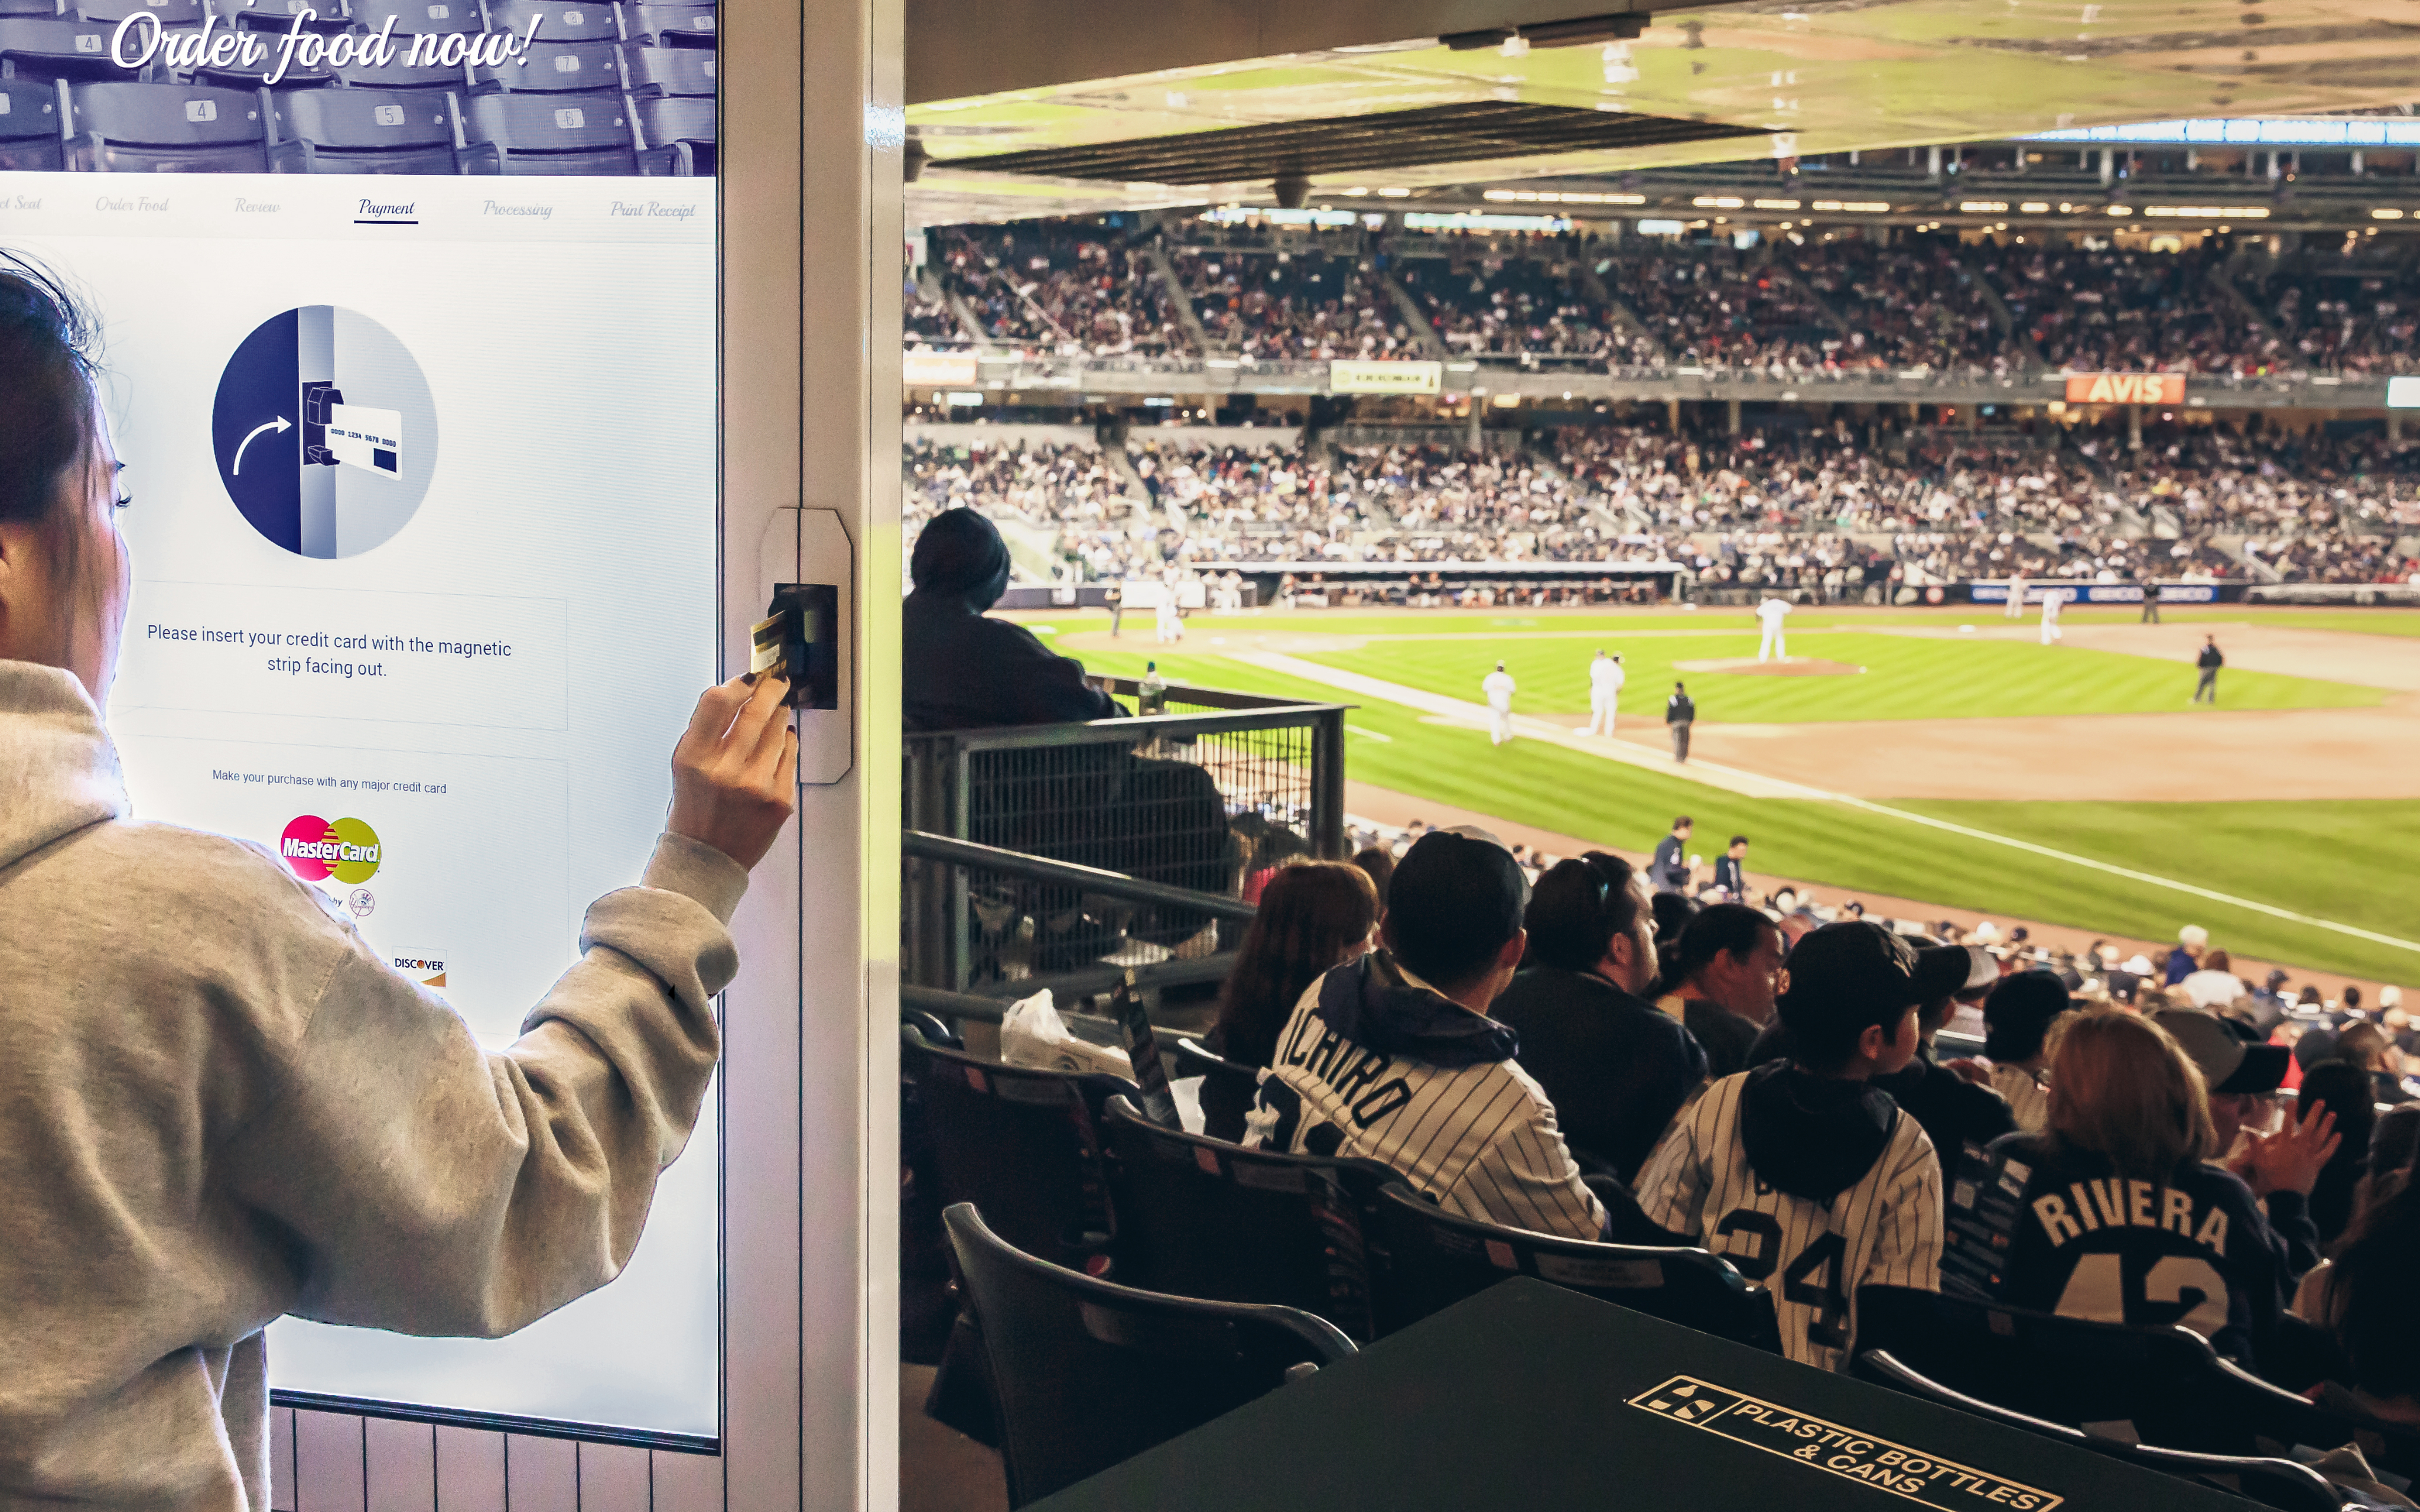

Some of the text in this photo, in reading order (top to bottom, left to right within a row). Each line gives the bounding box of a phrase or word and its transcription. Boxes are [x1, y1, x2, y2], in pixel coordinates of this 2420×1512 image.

[111, 8, 543, 85] Order food now!
[197, 102, 206, 119] 4
[385, 107, 394, 123] 5
[15, 195, 42, 210] Seat
[96, 196, 169, 212] Order Food
[235, 197, 281, 213] Review
[359, 198, 415, 218] Payment
[483, 200, 553, 220] Processing
[611, 201, 696, 221] Print Receipt
[2087, 374, 2163, 404] AVIS
[347, 431, 362, 439] 1234
[148, 624, 512, 659] Please insert your credit card with the magnetic
[268, 656, 387, 679] strip facing out.
[213, 769, 447, 794] Make your purchase with any major credit card
[282, 837, 379, 863] MasterCard
[394, 957, 444, 971] DISCOVER
[1279, 1007, 1413, 1129] ICHIRO
[2031, 1178, 2229, 1257] RIVERA
[1733, 1403, 2041, 1510] PLASTIC BOTTLES
[1793, 1444, 1926, 1494] & CANS
